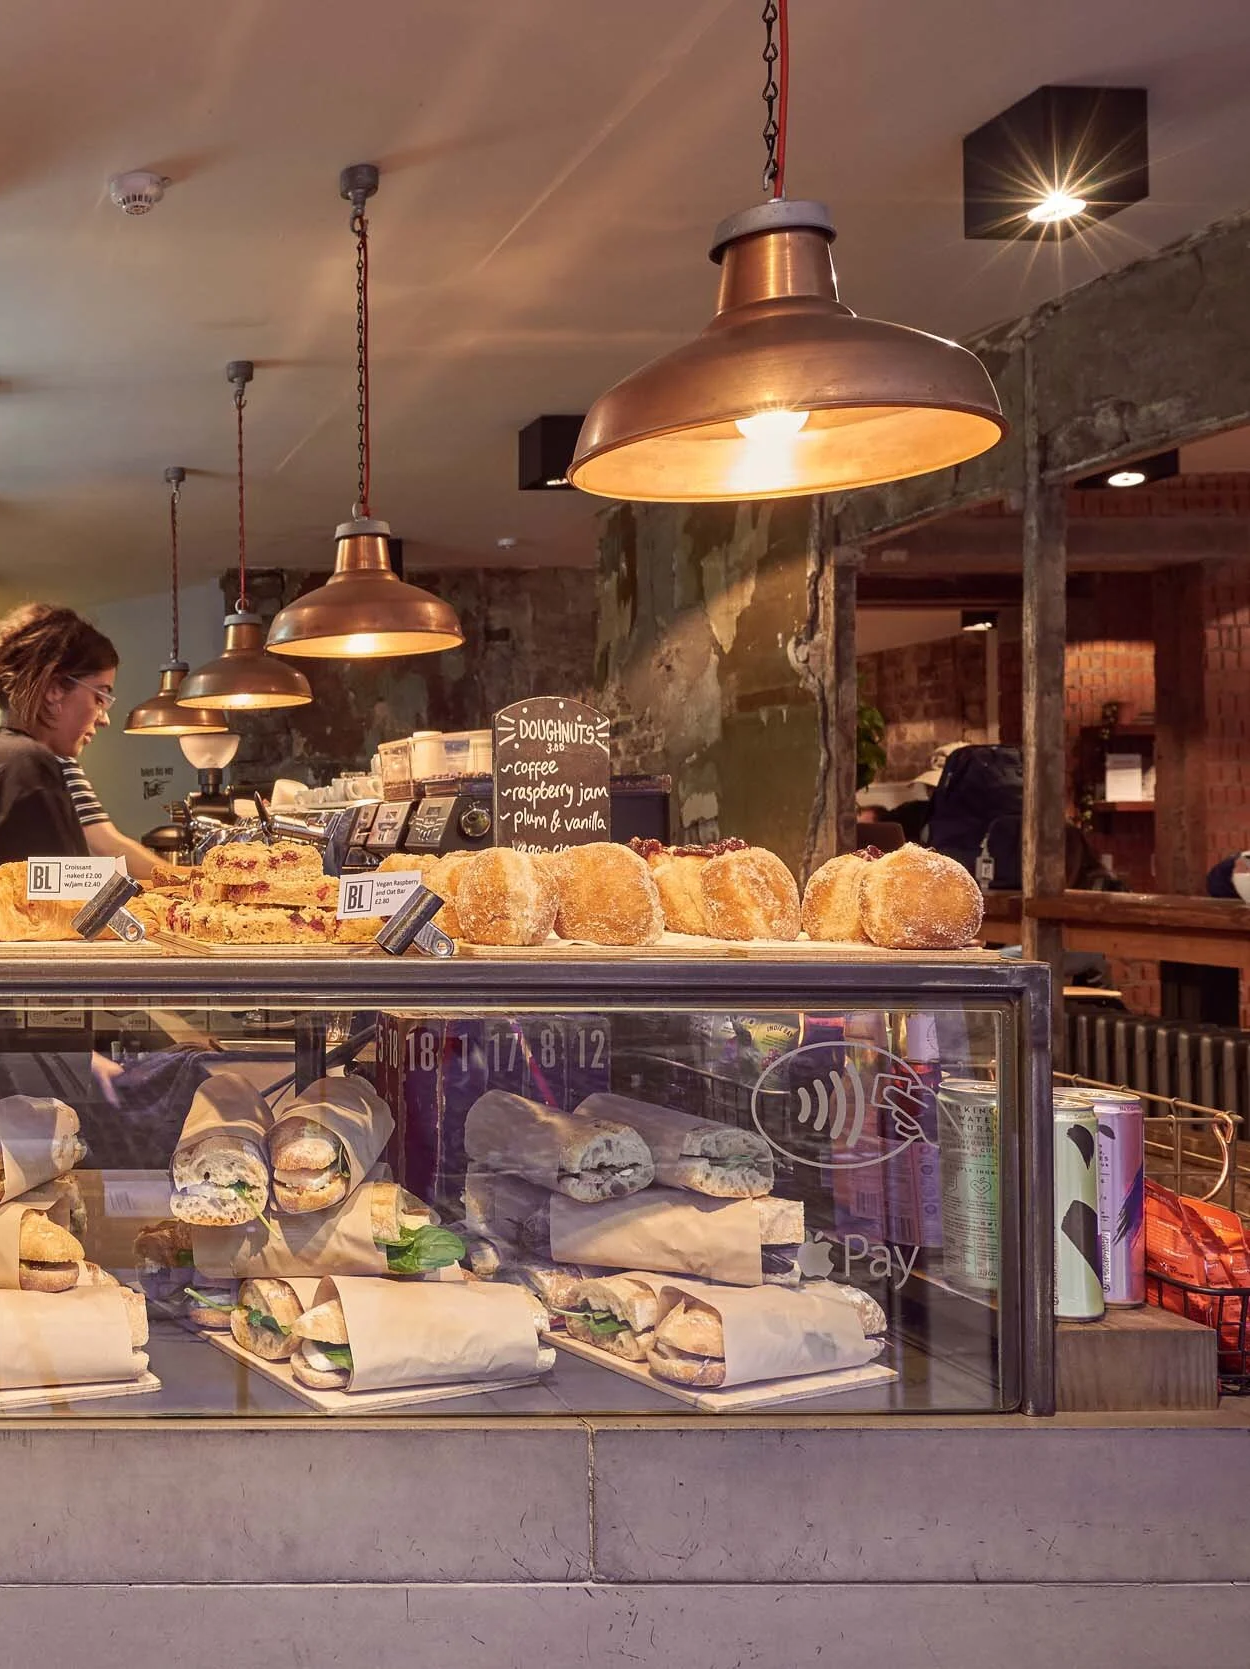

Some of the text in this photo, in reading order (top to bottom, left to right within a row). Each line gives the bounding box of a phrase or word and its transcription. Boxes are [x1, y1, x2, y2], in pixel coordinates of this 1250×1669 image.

[519, 719, 595, 744] DOUGHNUTS
[514, 760, 559, 781] coffee
[512, 781, 609, 809] raspberry jam
[514, 808, 607, 833] plum & vanilla
[33, 866, 52, 889] BL
[394, 879, 419, 887] Raspberry
[347, 885, 364, 909] BL
[388, 1028, 398, 1069] 18
[406, 1033, 435, 1072] 18
[459, 1033, 468, 1072] 1
[491, 1033, 520, 1072] 17
[540, 1029, 556, 1068] 8
[577, 1029, 605, 1068] 12
[844, 1234, 920, 1289] Pay
